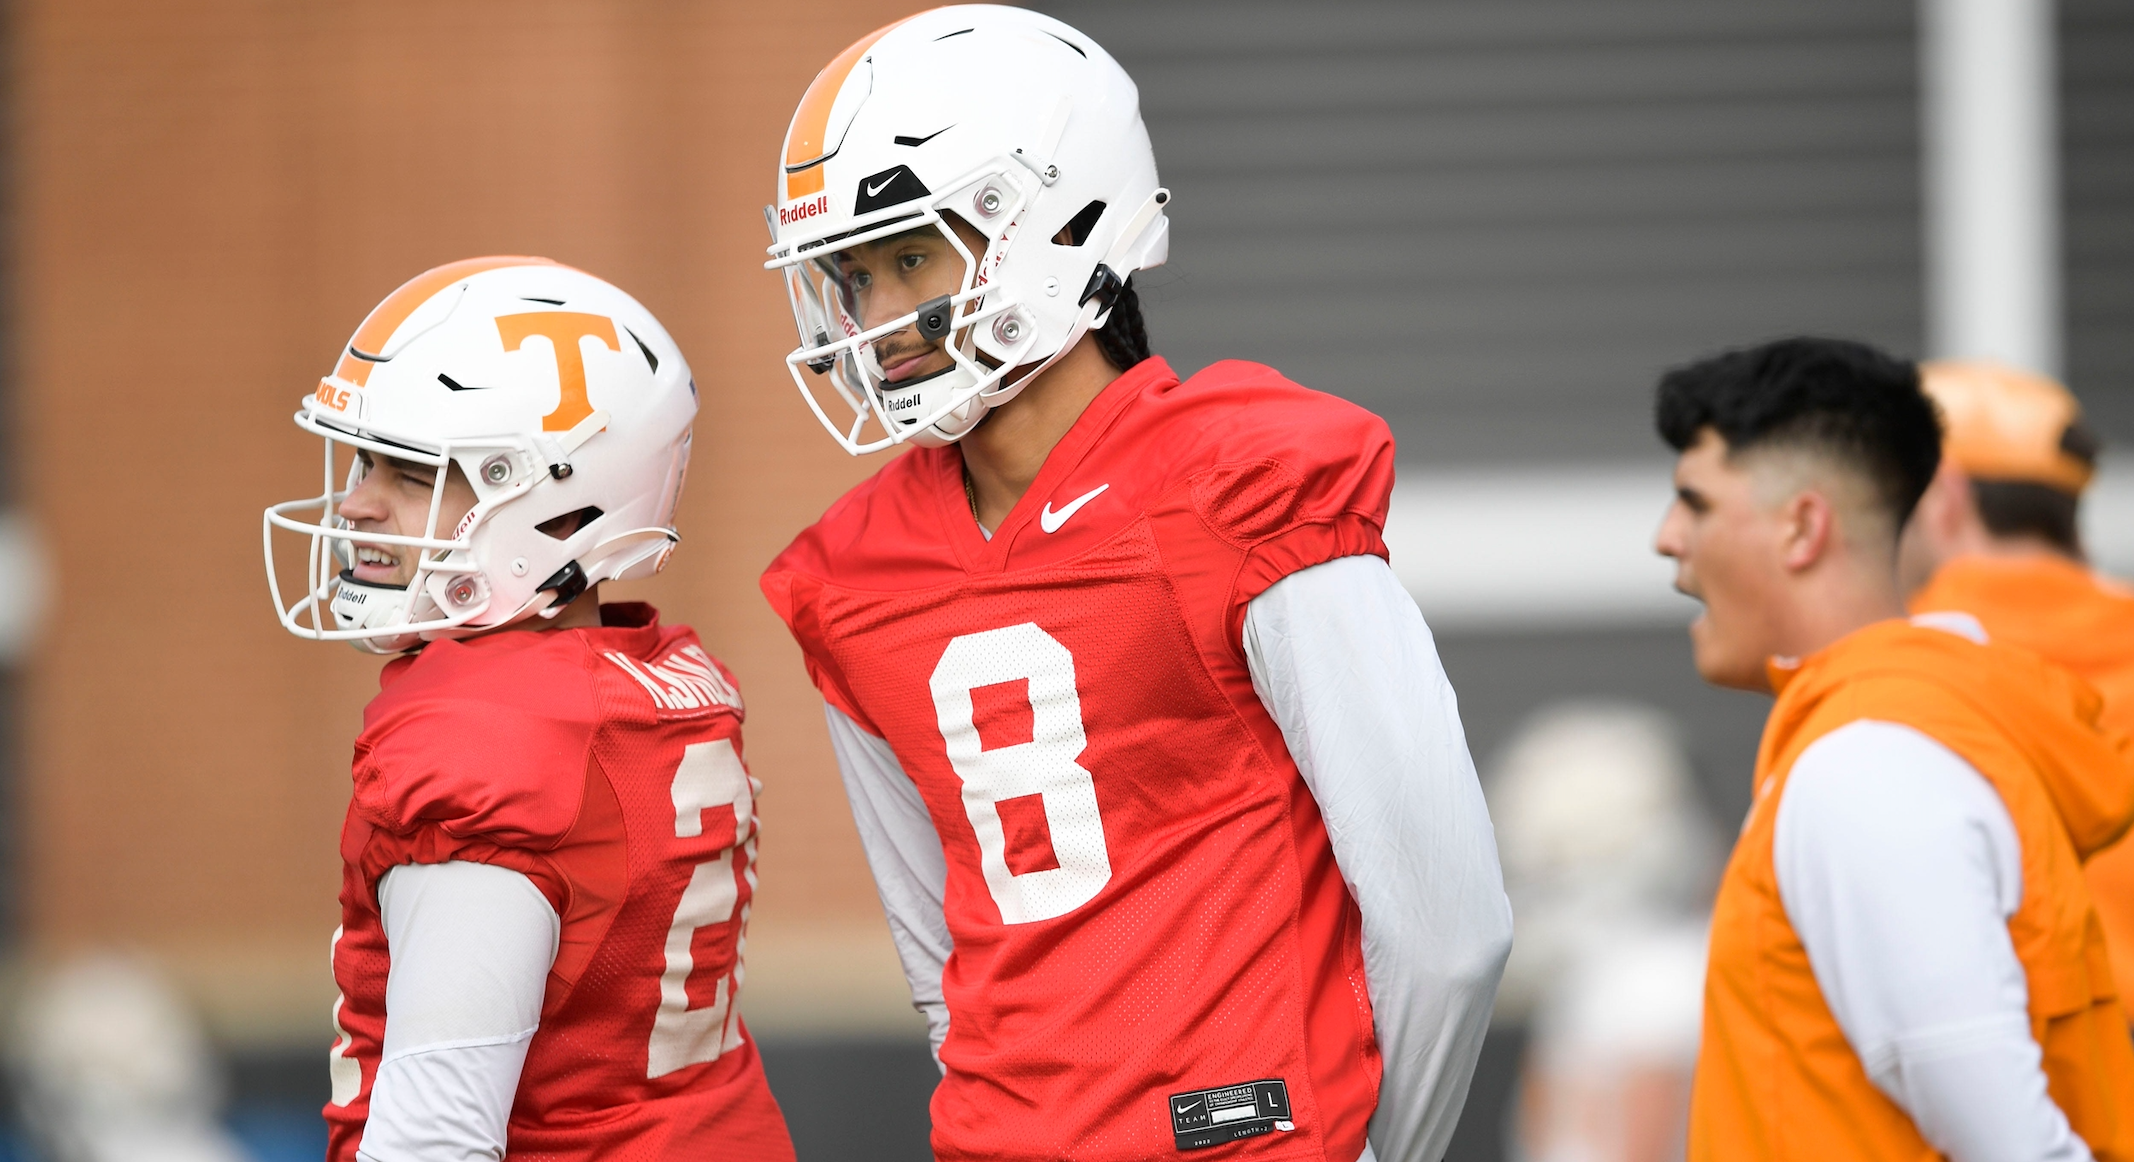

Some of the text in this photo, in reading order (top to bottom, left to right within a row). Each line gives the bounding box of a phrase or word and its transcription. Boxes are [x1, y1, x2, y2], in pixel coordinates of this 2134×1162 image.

[780, 195, 828, 226] Riddell
[494, 311, 622, 432] T
[888, 393, 922, 412] Riddell
[928, 621, 1113, 926] 8
[1207, 1087, 1253, 1100] ENGINEERED
[1267, 1091, 1279, 1108] L
[1178, 1114, 1207, 1125] TEAM
